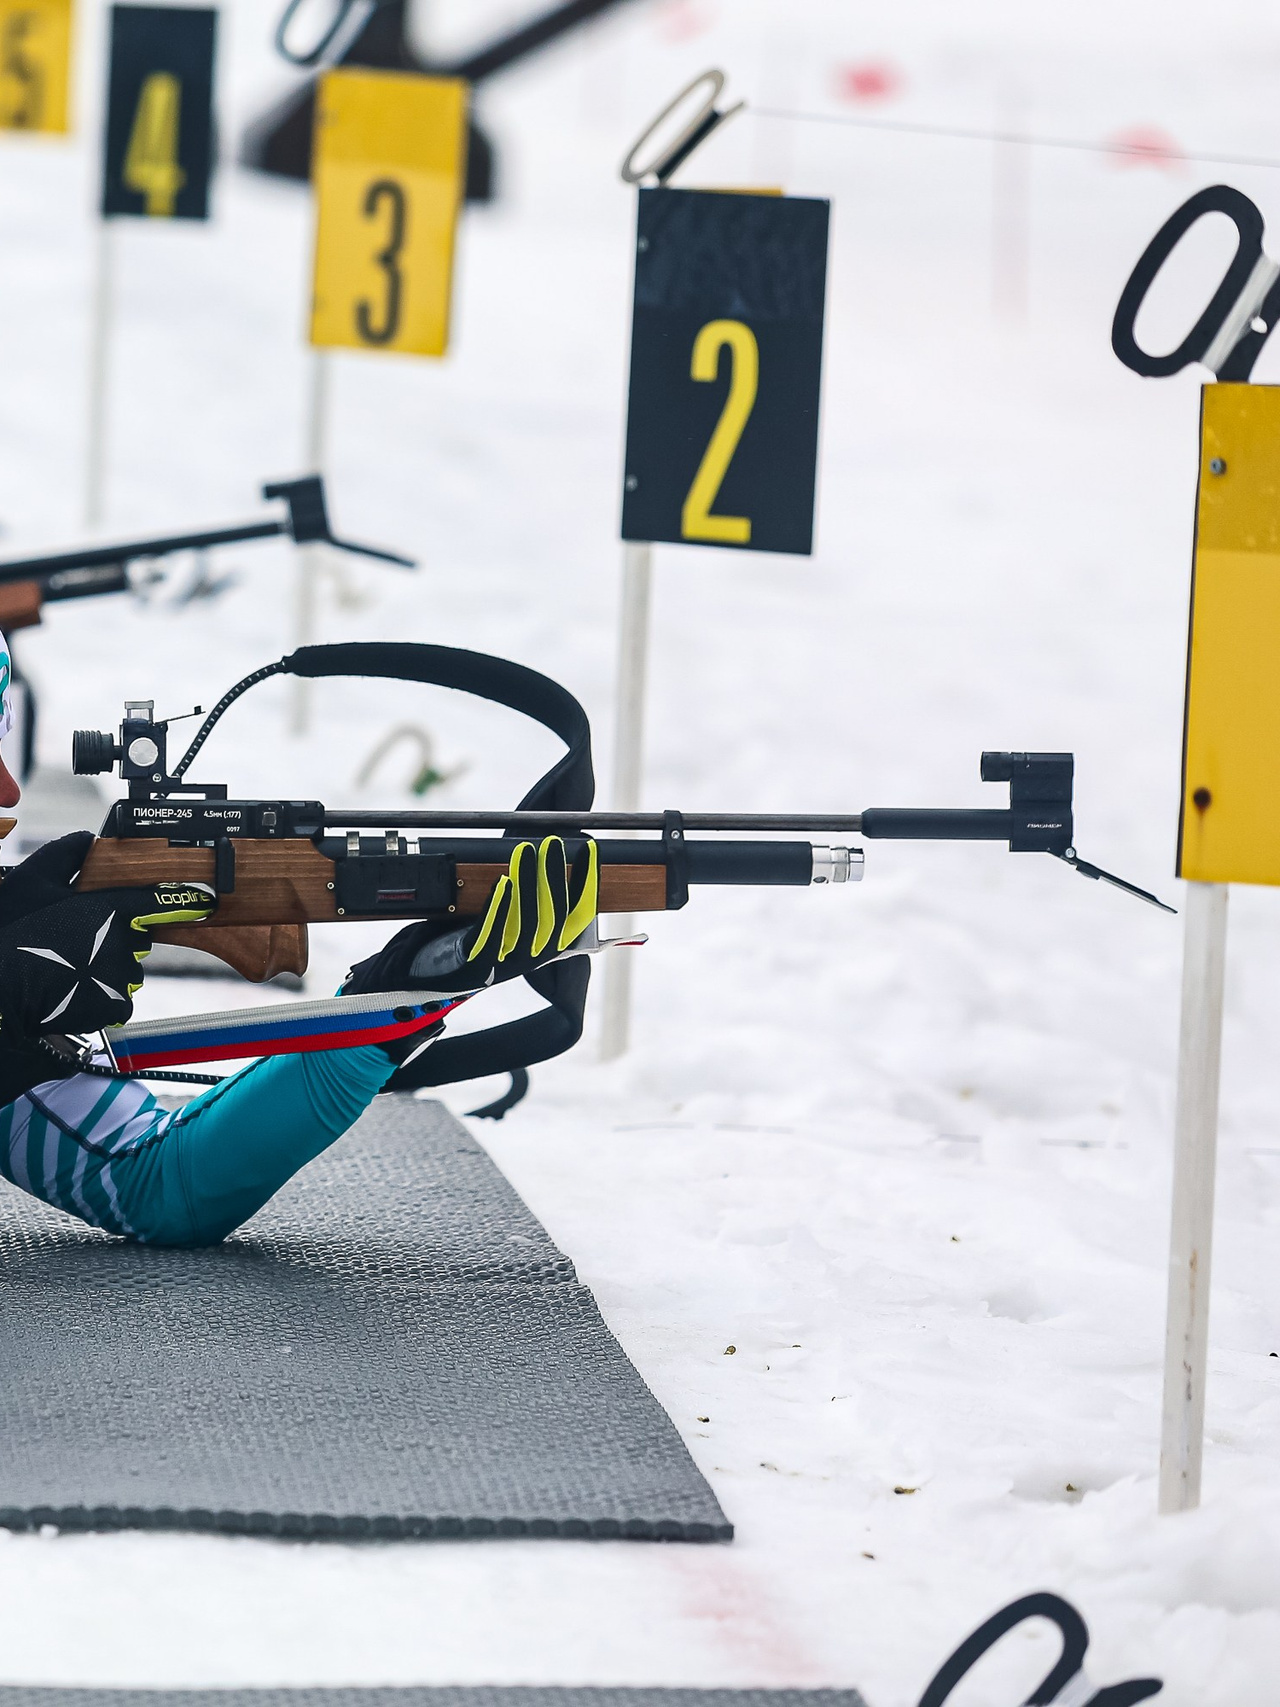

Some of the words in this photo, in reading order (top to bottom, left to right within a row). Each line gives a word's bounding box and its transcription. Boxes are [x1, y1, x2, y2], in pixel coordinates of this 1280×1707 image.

[123, 70, 187, 218] 4
[355, 178, 407, 346] 3
[681, 318, 760, 545] 2
[133, 807, 193, 819] ПИОНЕР-245
